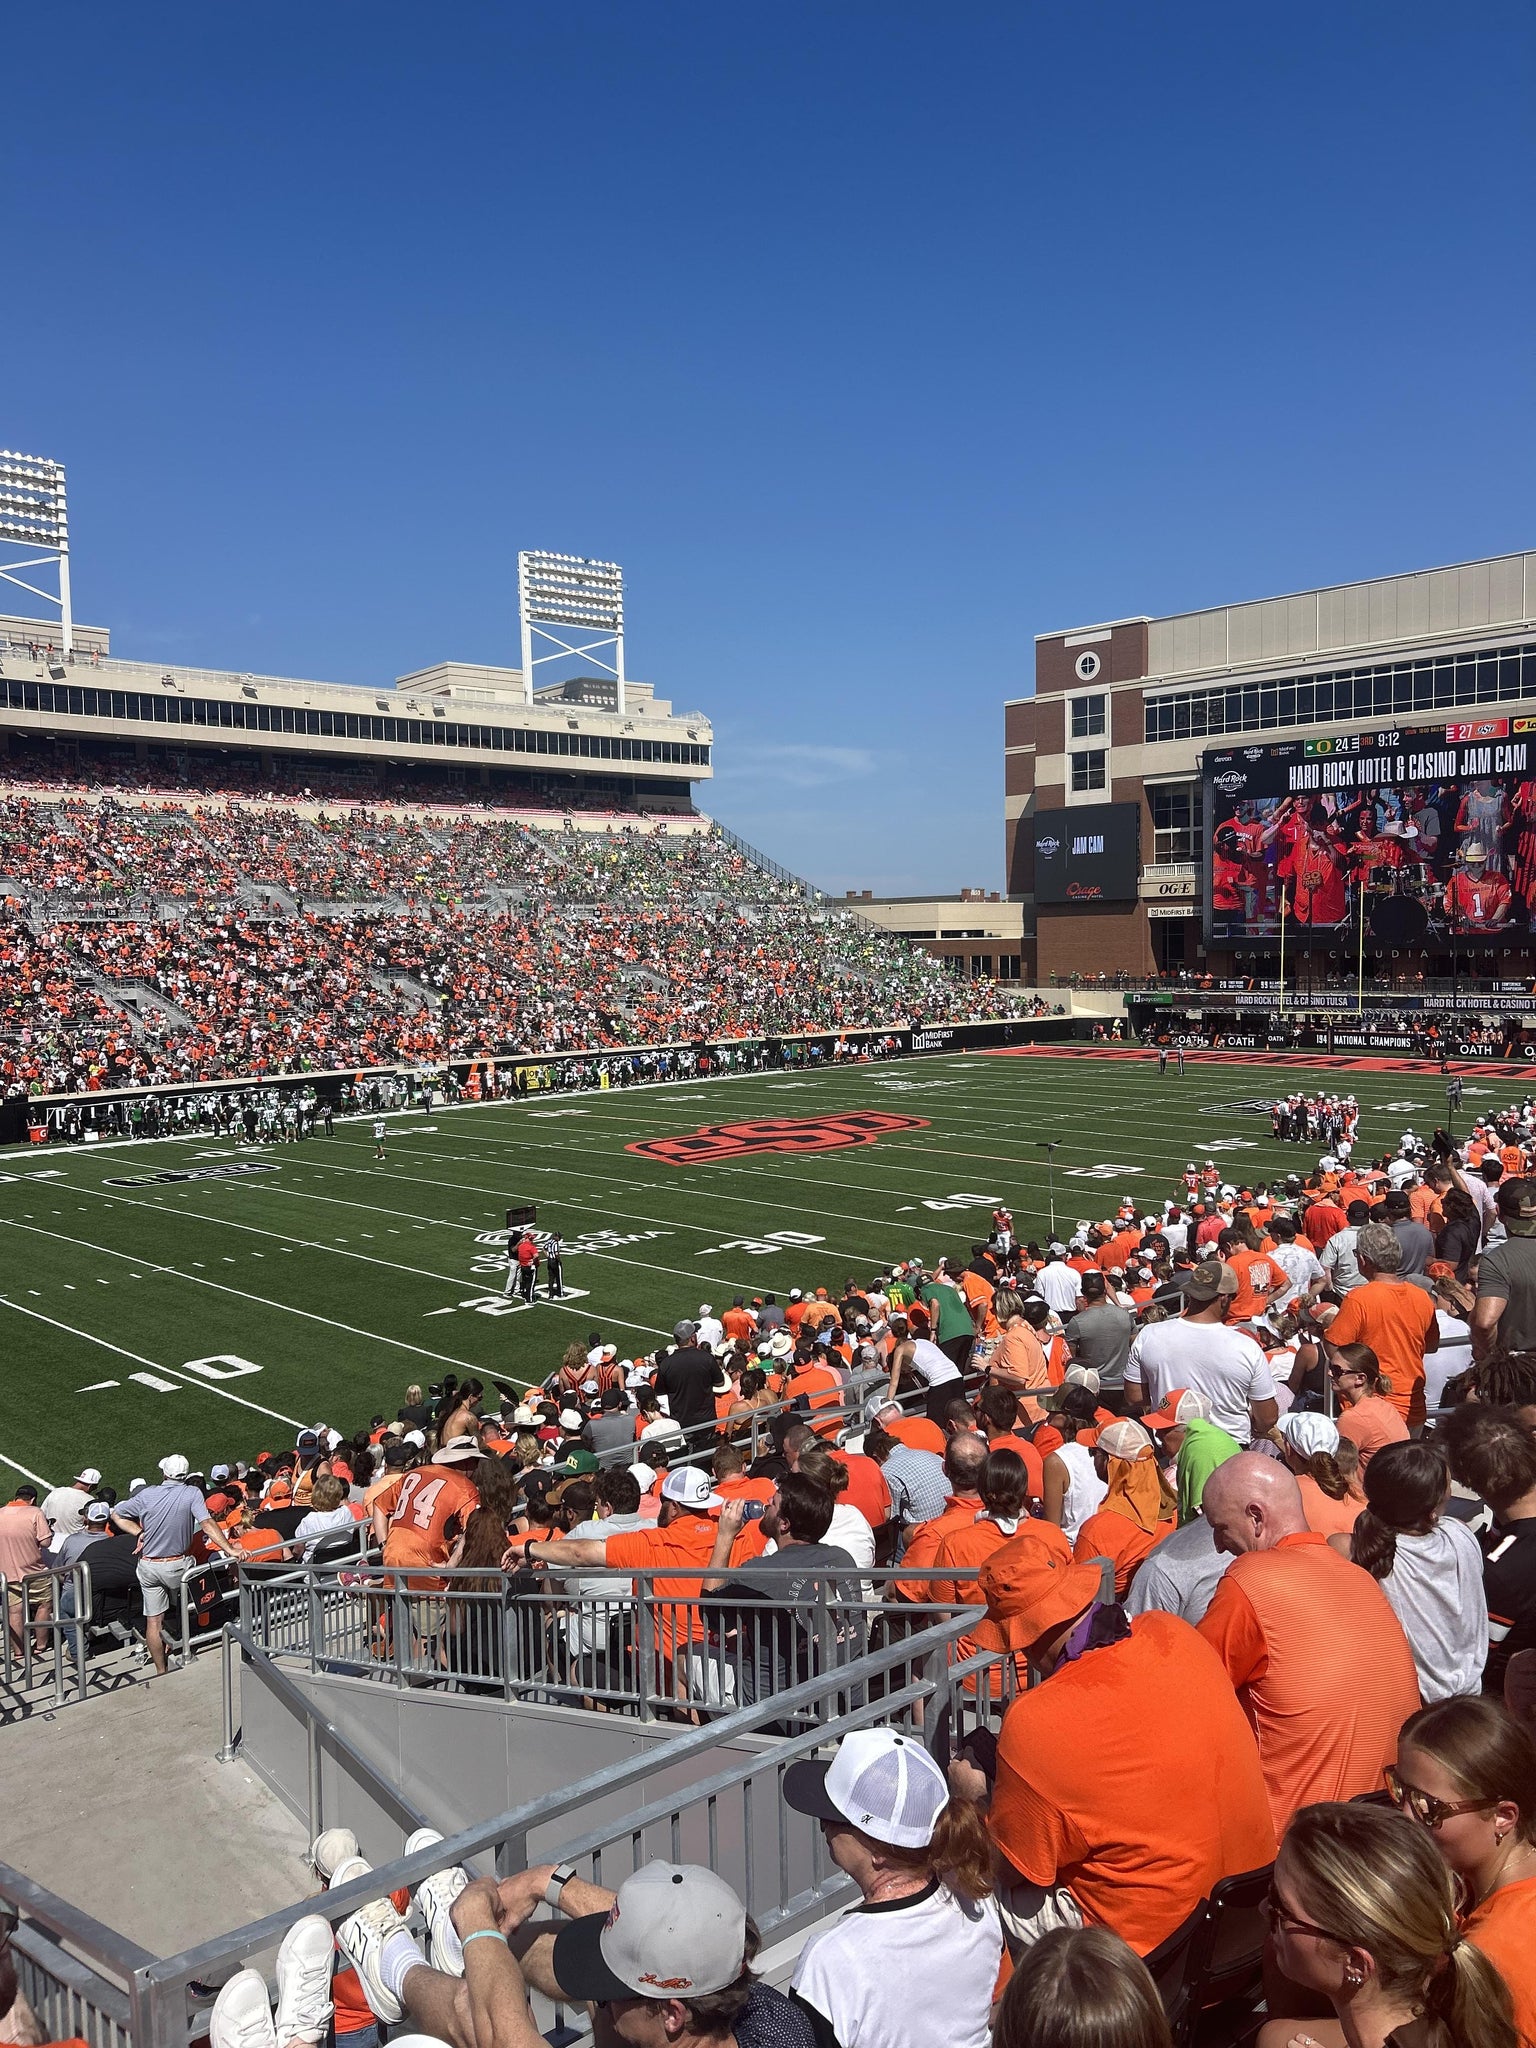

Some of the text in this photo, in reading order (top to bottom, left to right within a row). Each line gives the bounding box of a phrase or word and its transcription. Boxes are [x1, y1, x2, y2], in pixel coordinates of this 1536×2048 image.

[1459, 724, 1473, 739] 27
[1316, 738, 1348, 753] O 24
[1360, 732, 1400, 747] 3RD 9:12
[1289, 744, 1526, 790] HARD ROCK HOTEL & CASINO JAM CAM
[1213, 773, 1248, 784] Hard Rock
[1072, 836, 1104, 854] JAM CAM
[1066, 882, 1102, 900] Osage
[1472, 894, 1484, 917] 1
[1235, 951, 1284, 959] GAR
[1329, 950, 1429, 959] CLAUDIA
[1236, 996, 1253, 1005] HARD
[1254, 996, 1272, 1005] ROCK
[1273, 997, 1293, 1005] HOTEL
[1300, 997, 1325, 1006] CASINO
[1327, 997, 1347, 1006] TULSA
[1424, 999, 1444, 1008] HARD
[1468, 999, 1491, 1008] HOTEL
[1493, 1000, 1499, 1008] &
[1501, 1000, 1530, 1009] CASINO
[925, 1040, 943, 1048] BANK
[1179, 1035, 1203, 1044] OATH
[1228, 1037, 1255, 1046] OATH
[1316, 1035, 1410, 1047] 194 NATIONAL CHAMPIONS
[1460, 1045, 1492, 1055] OATH
[1062, 1164, 1145, 1179] 50
[921, 1193, 1004, 1211] 40
[719, 1230, 826, 1254] 30
[128, 1355, 264, 1393] 10
[391, 1472, 447, 1530] 84
[1486, 1535, 1518, 1563] 1
[199, 1578, 205, 1590] 7
